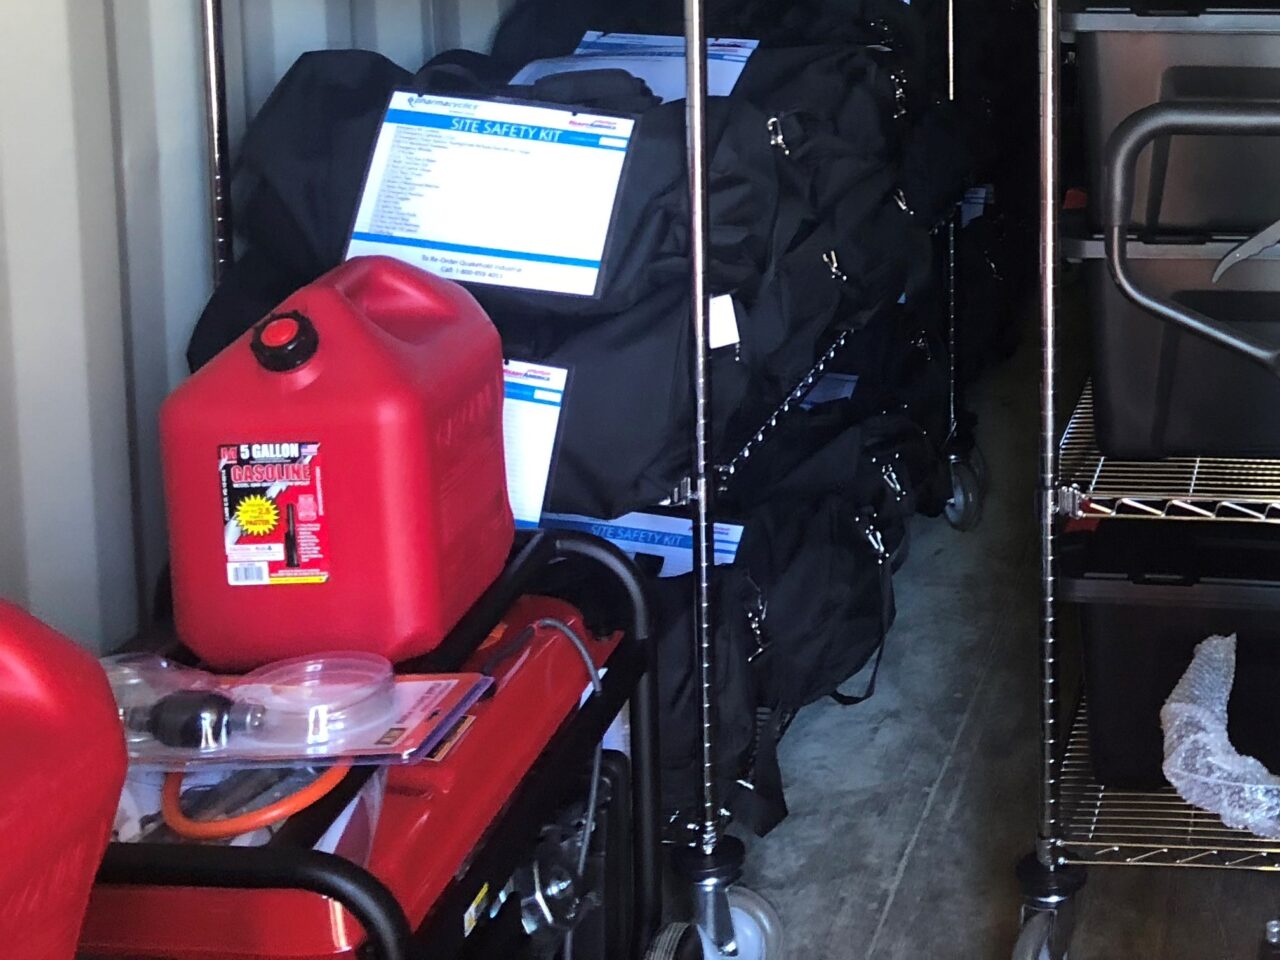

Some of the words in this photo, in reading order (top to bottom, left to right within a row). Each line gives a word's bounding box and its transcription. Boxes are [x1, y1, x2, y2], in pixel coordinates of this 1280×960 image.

[451, 118, 482, 133] SITE
[483, 121, 536, 140] SAFETY
[538, 126, 563, 142] KIT
[240, 445, 250, 460] 5
[252, 442, 299, 459] GALLON
[231, 464, 311, 482] GASOLINE
[590, 524, 614, 539] SITE
[615, 526, 662, 546] SAFETY
[662, 533, 684, 546] KIT
